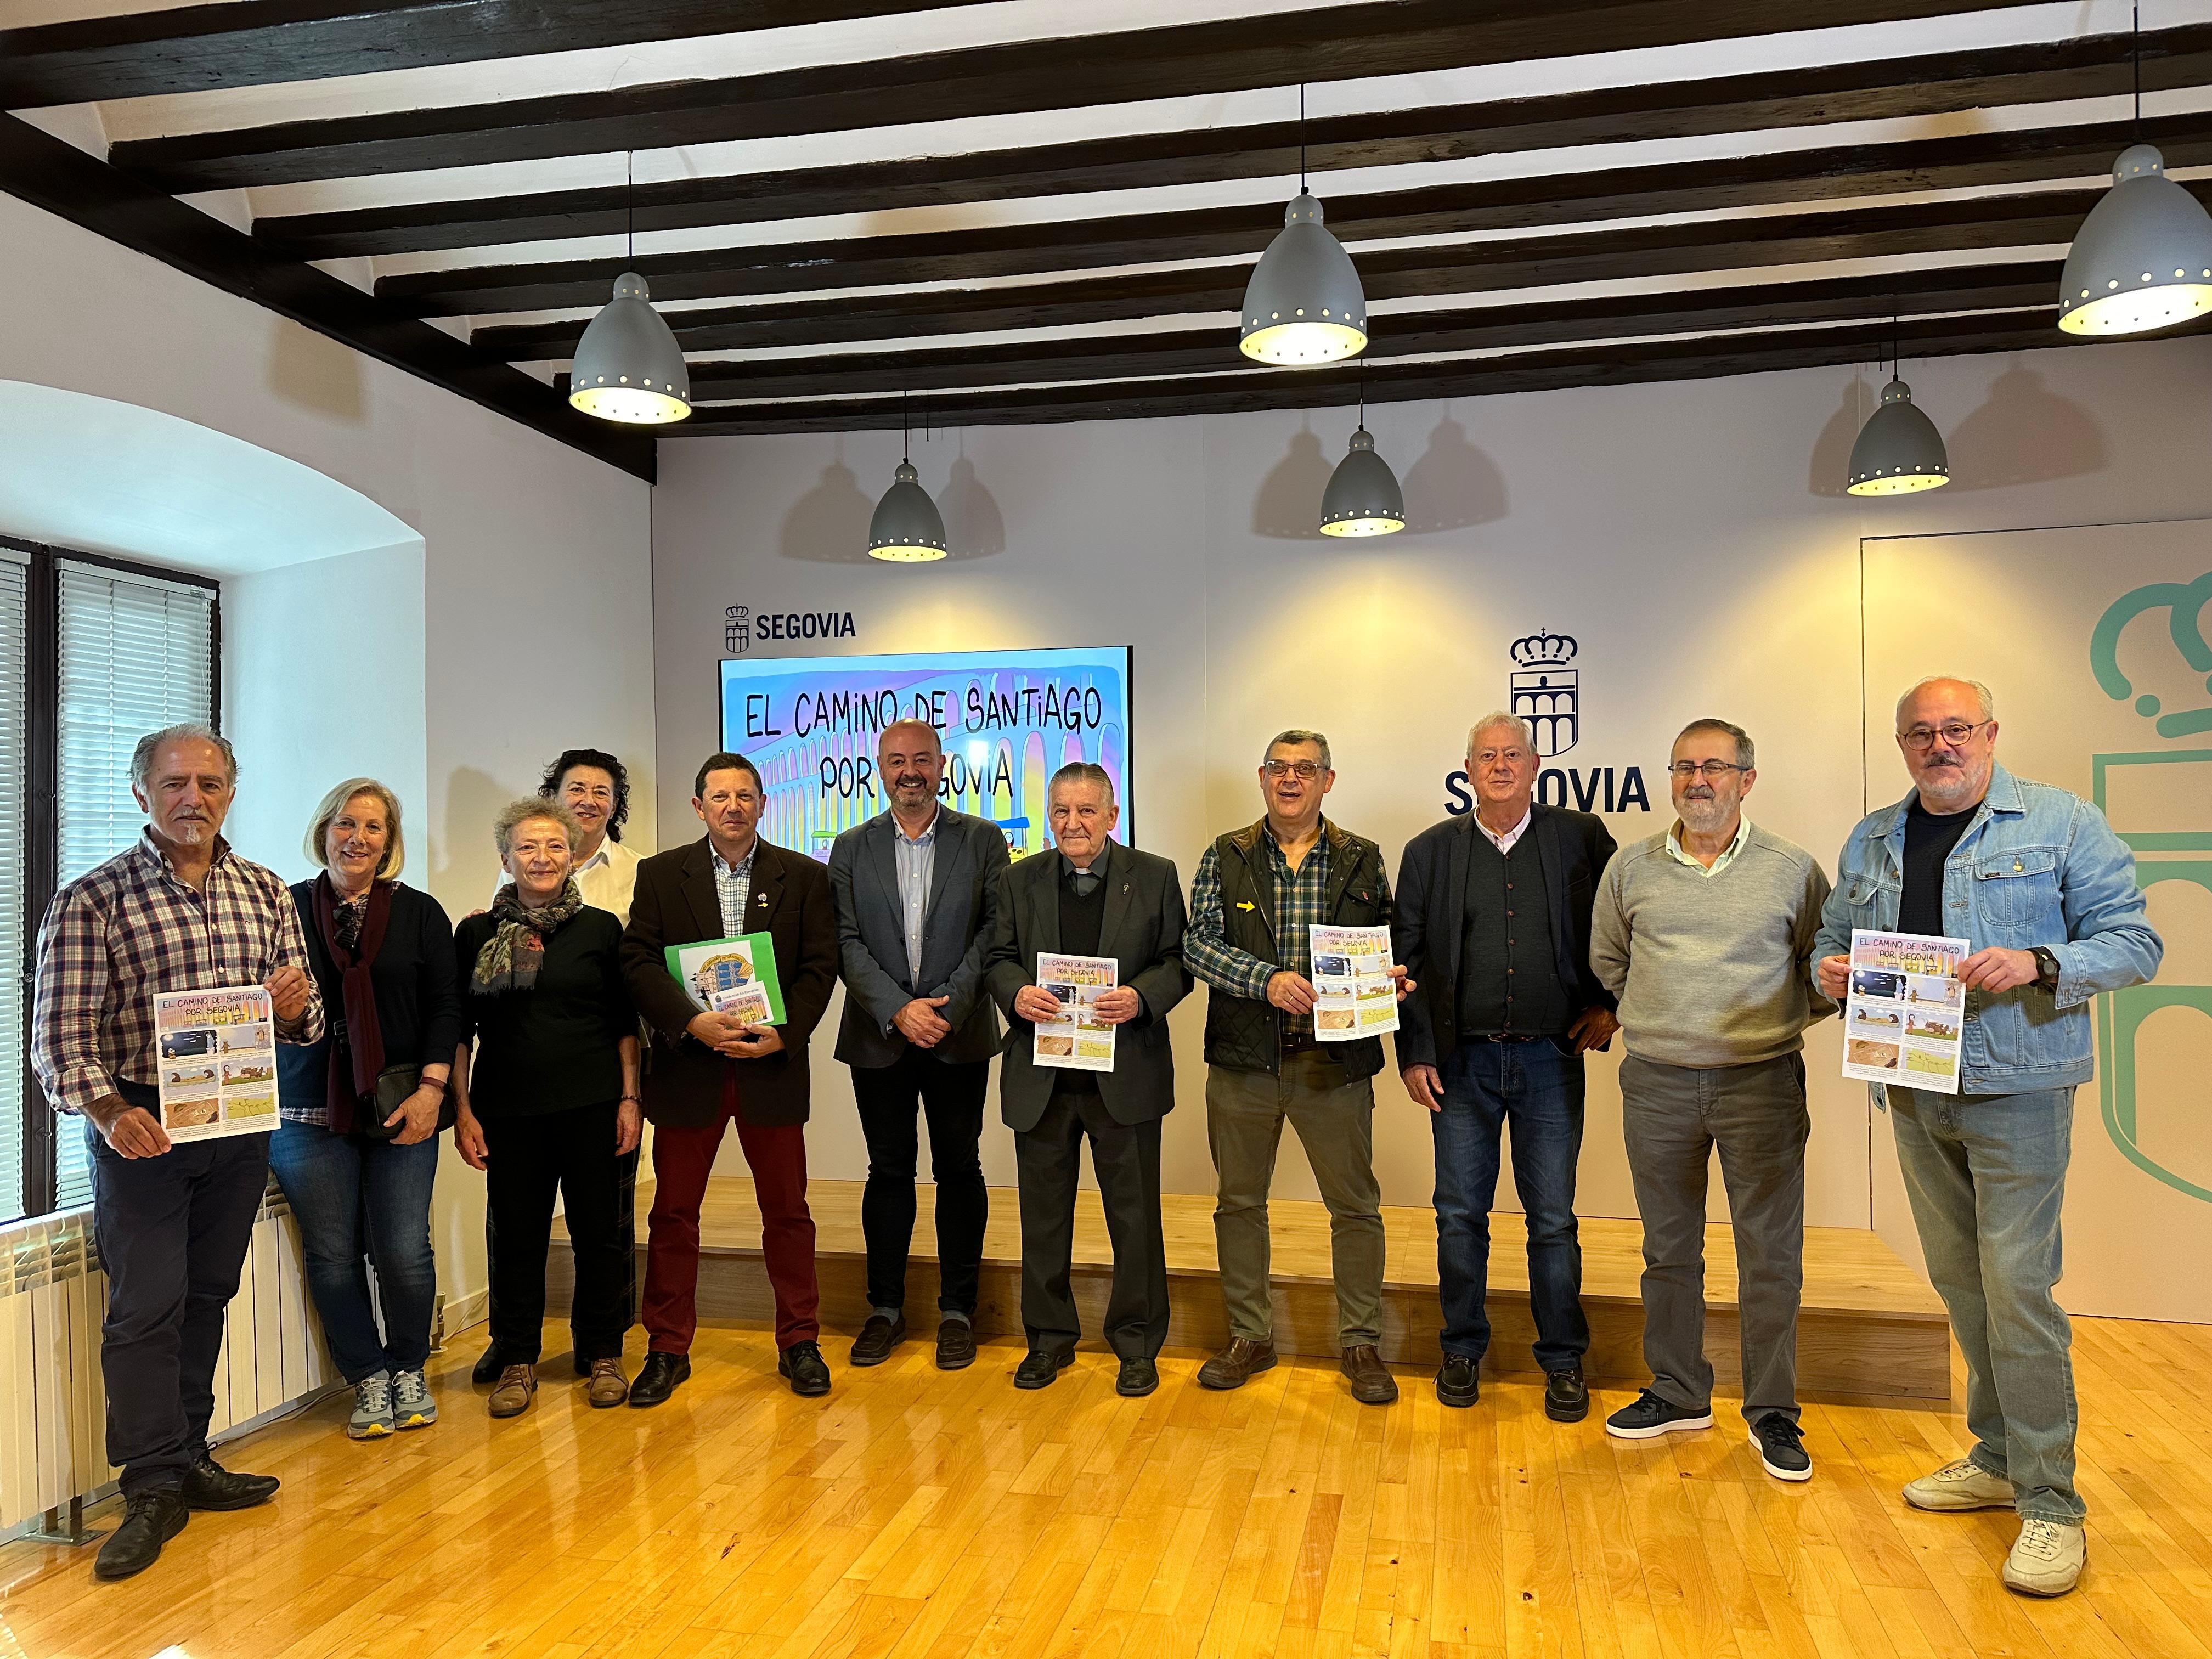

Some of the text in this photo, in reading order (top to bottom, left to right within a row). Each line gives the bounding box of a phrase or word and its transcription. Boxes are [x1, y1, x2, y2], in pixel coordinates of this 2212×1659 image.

[756, 612, 856, 640] SEGOVIA
[747, 693, 781, 737] EL
[915, 691, 947, 729] DE
[820, 756, 875, 799] POR
[1444, 766, 1650, 816] SOVIA
[1860, 938, 1870, 946] EL
[1880, 950, 1934, 962] POR SEGOVIA
[206, 1004, 241, 1014] SEGOVIA
